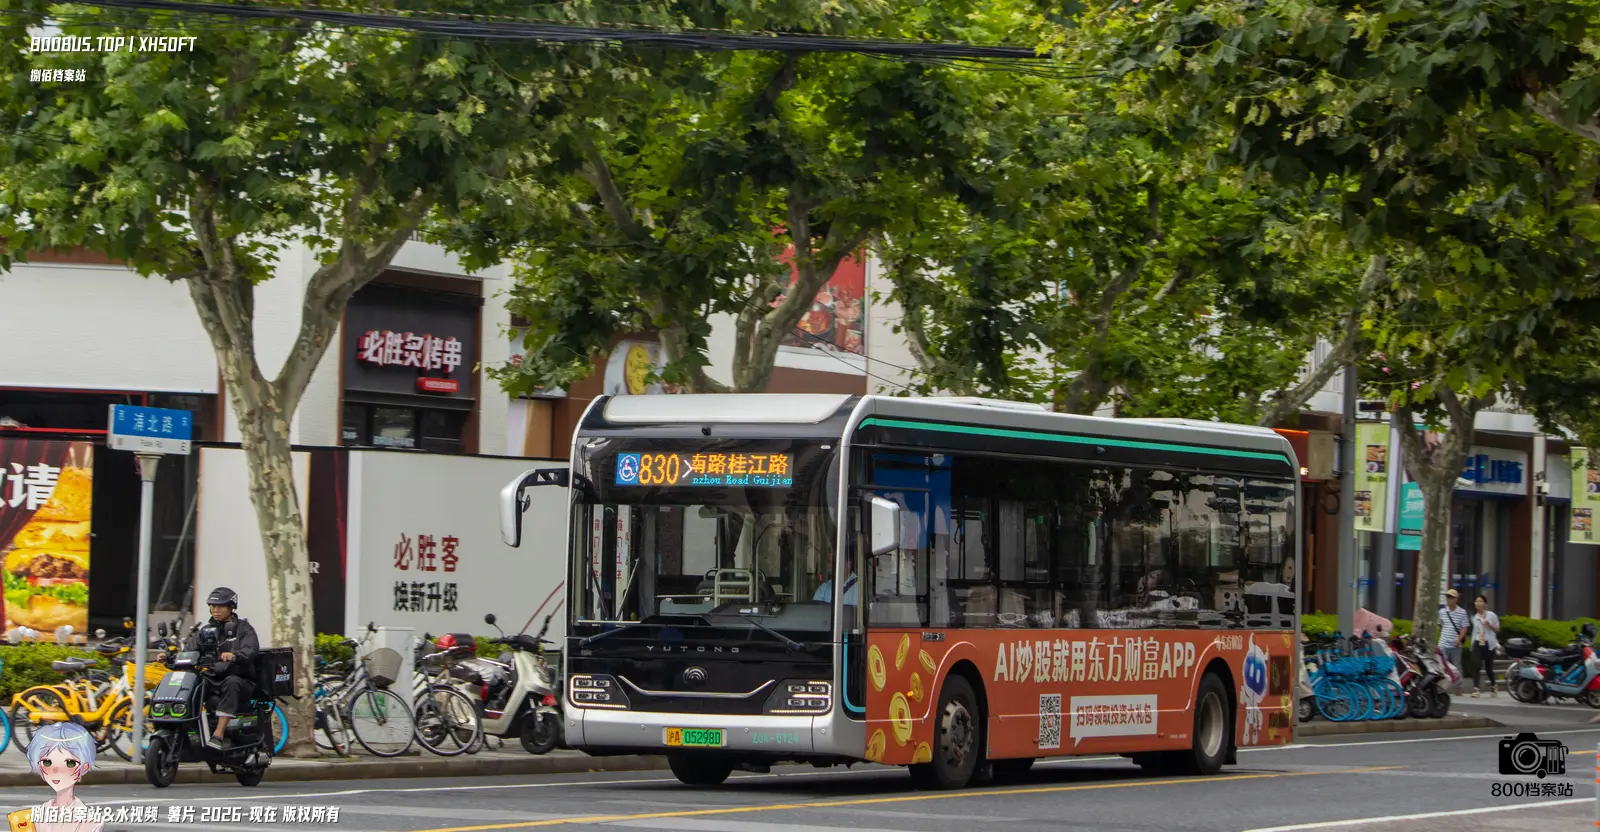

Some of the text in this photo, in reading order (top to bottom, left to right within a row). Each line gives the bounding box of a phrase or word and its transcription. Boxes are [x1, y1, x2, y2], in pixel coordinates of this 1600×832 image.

[359, 330, 462, 373] 必胜炙烤串
[638, 453, 680, 485] 830
[691, 453, 789, 475] 南路桂江路
[0, 462, 61, 511] 请
[726, 474, 749, 485] Road
[753, 475, 793, 487] Guijian
[393, 532, 459, 573] 必胜客
[393, 580, 459, 612] 焕新升级
[646, 645, 740, 653] YUTONG
[993, 636, 1196, 683] AI炒股就用东方财富APP
[1075, 703, 1153, 727] 扫码领取投资大礼包
